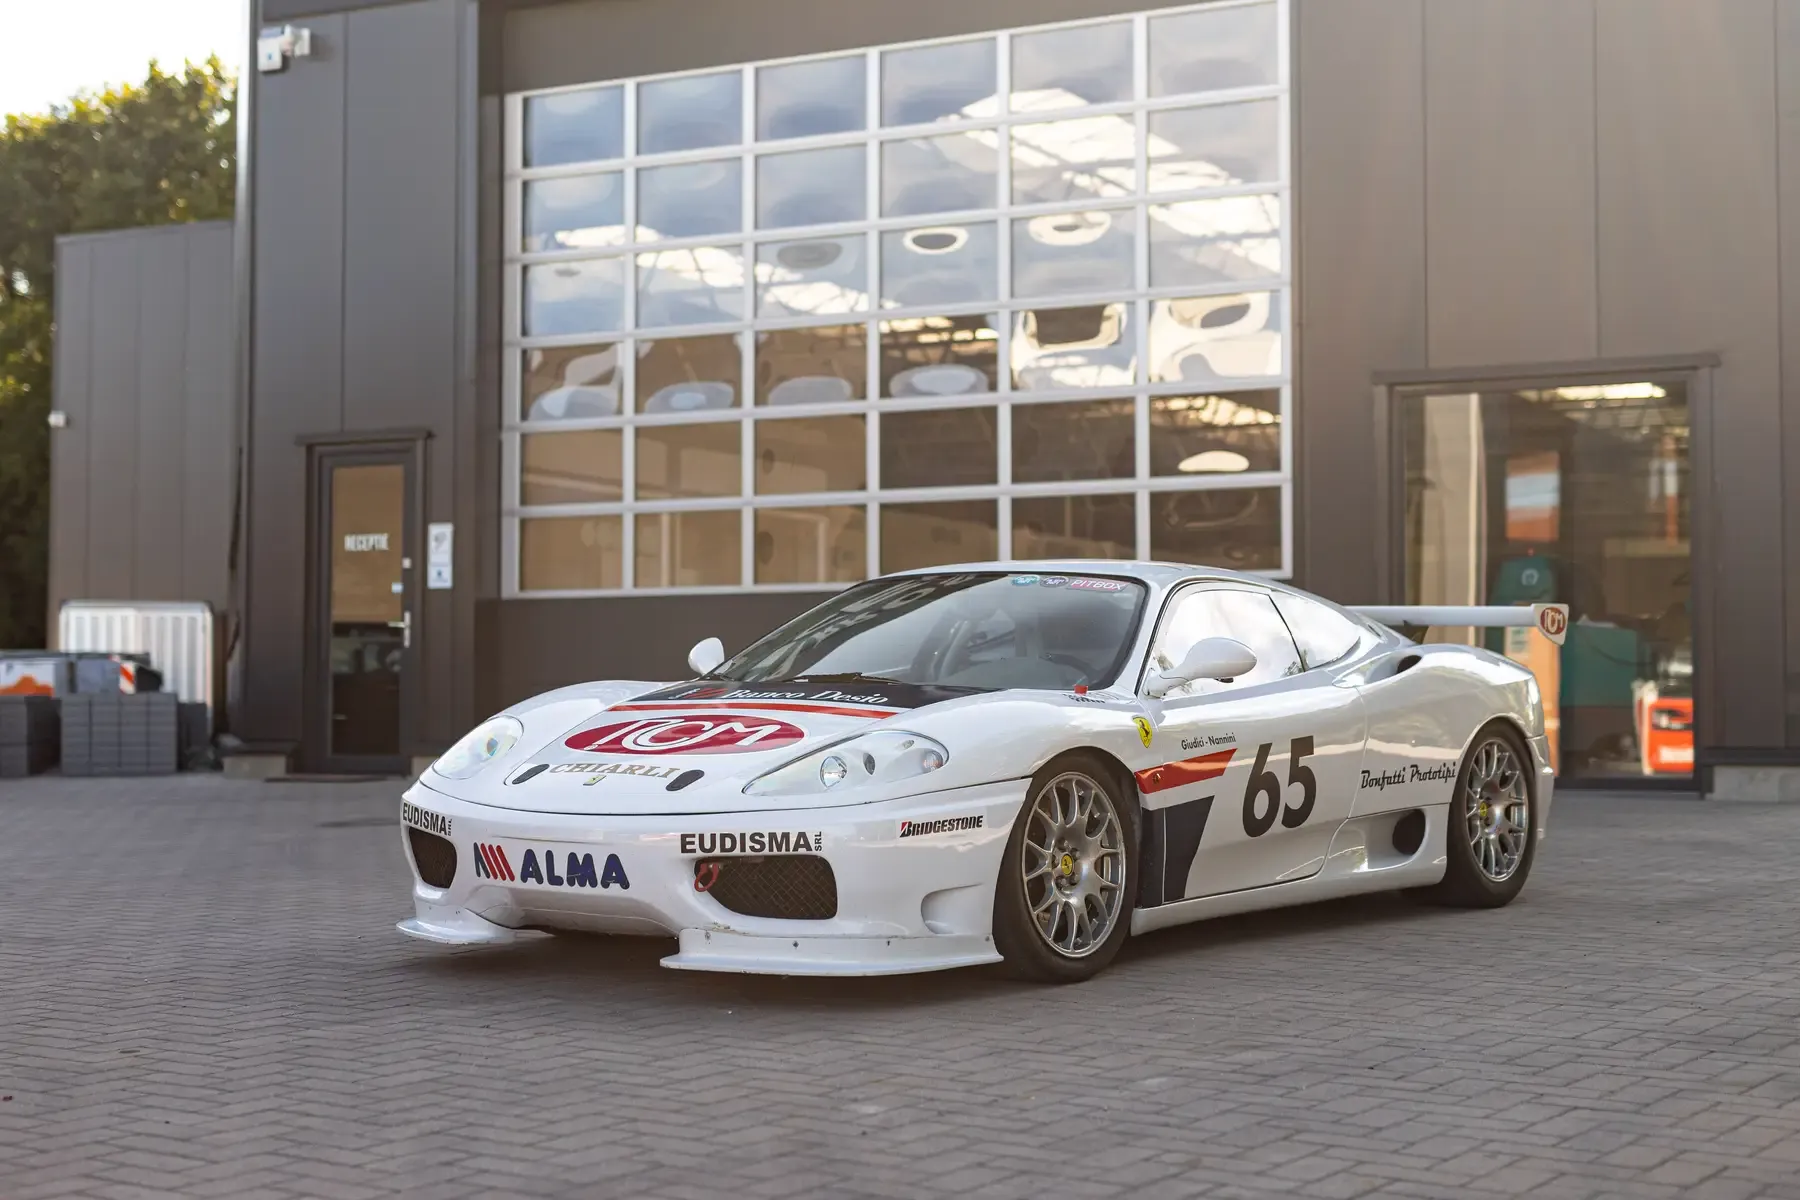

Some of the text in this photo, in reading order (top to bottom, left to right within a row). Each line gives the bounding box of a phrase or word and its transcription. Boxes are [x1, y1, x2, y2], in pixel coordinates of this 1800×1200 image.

[1070, 579, 1125, 591] PITBOX
[722, 689, 888, 704] Banco Desio
[1181, 736, 1205, 750] Giudici
[1208, 732, 1237, 746] Nannini
[550, 763, 680, 779] CHIARLI
[1361, 761, 1457, 791] Bonfatti Prototipi
[1242, 735, 1317, 837] 65
[402, 802, 447, 836] EUDISMA
[900, 815, 984, 838] BRIDGESTONE
[680, 831, 822, 854] EUDISMA SRL
[520, 848, 630, 890] ALMA
